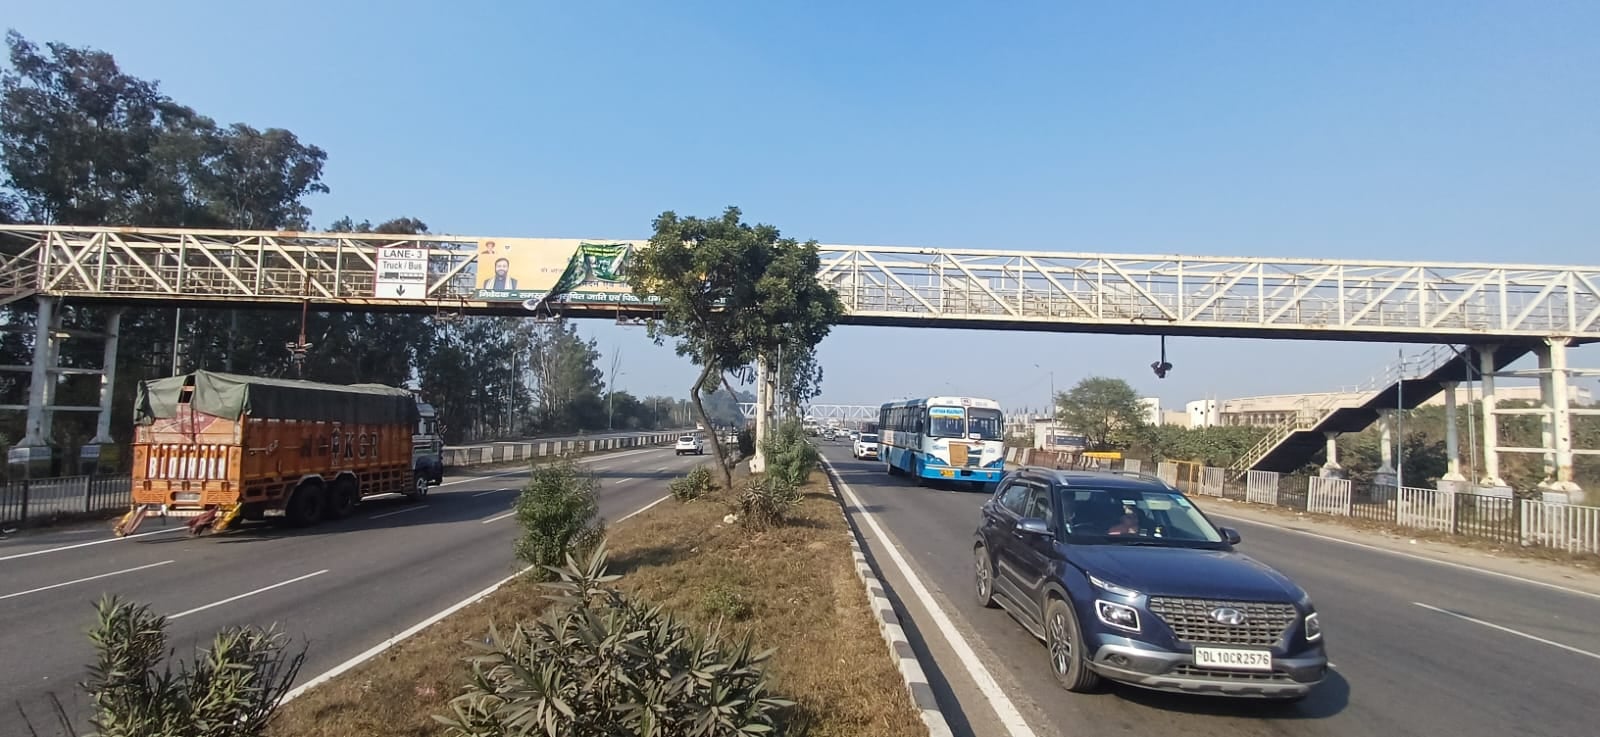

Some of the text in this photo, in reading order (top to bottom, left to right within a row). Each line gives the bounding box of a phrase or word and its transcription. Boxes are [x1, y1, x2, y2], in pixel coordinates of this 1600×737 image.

[384, 250, 422, 258] LANE- 3
[383, 261, 402, 270] Truck
[408, 262, 422, 270] Bus
[586, 292, 607, 301] जाति
[1203, 650, 1269, 665] DL10CR2576
